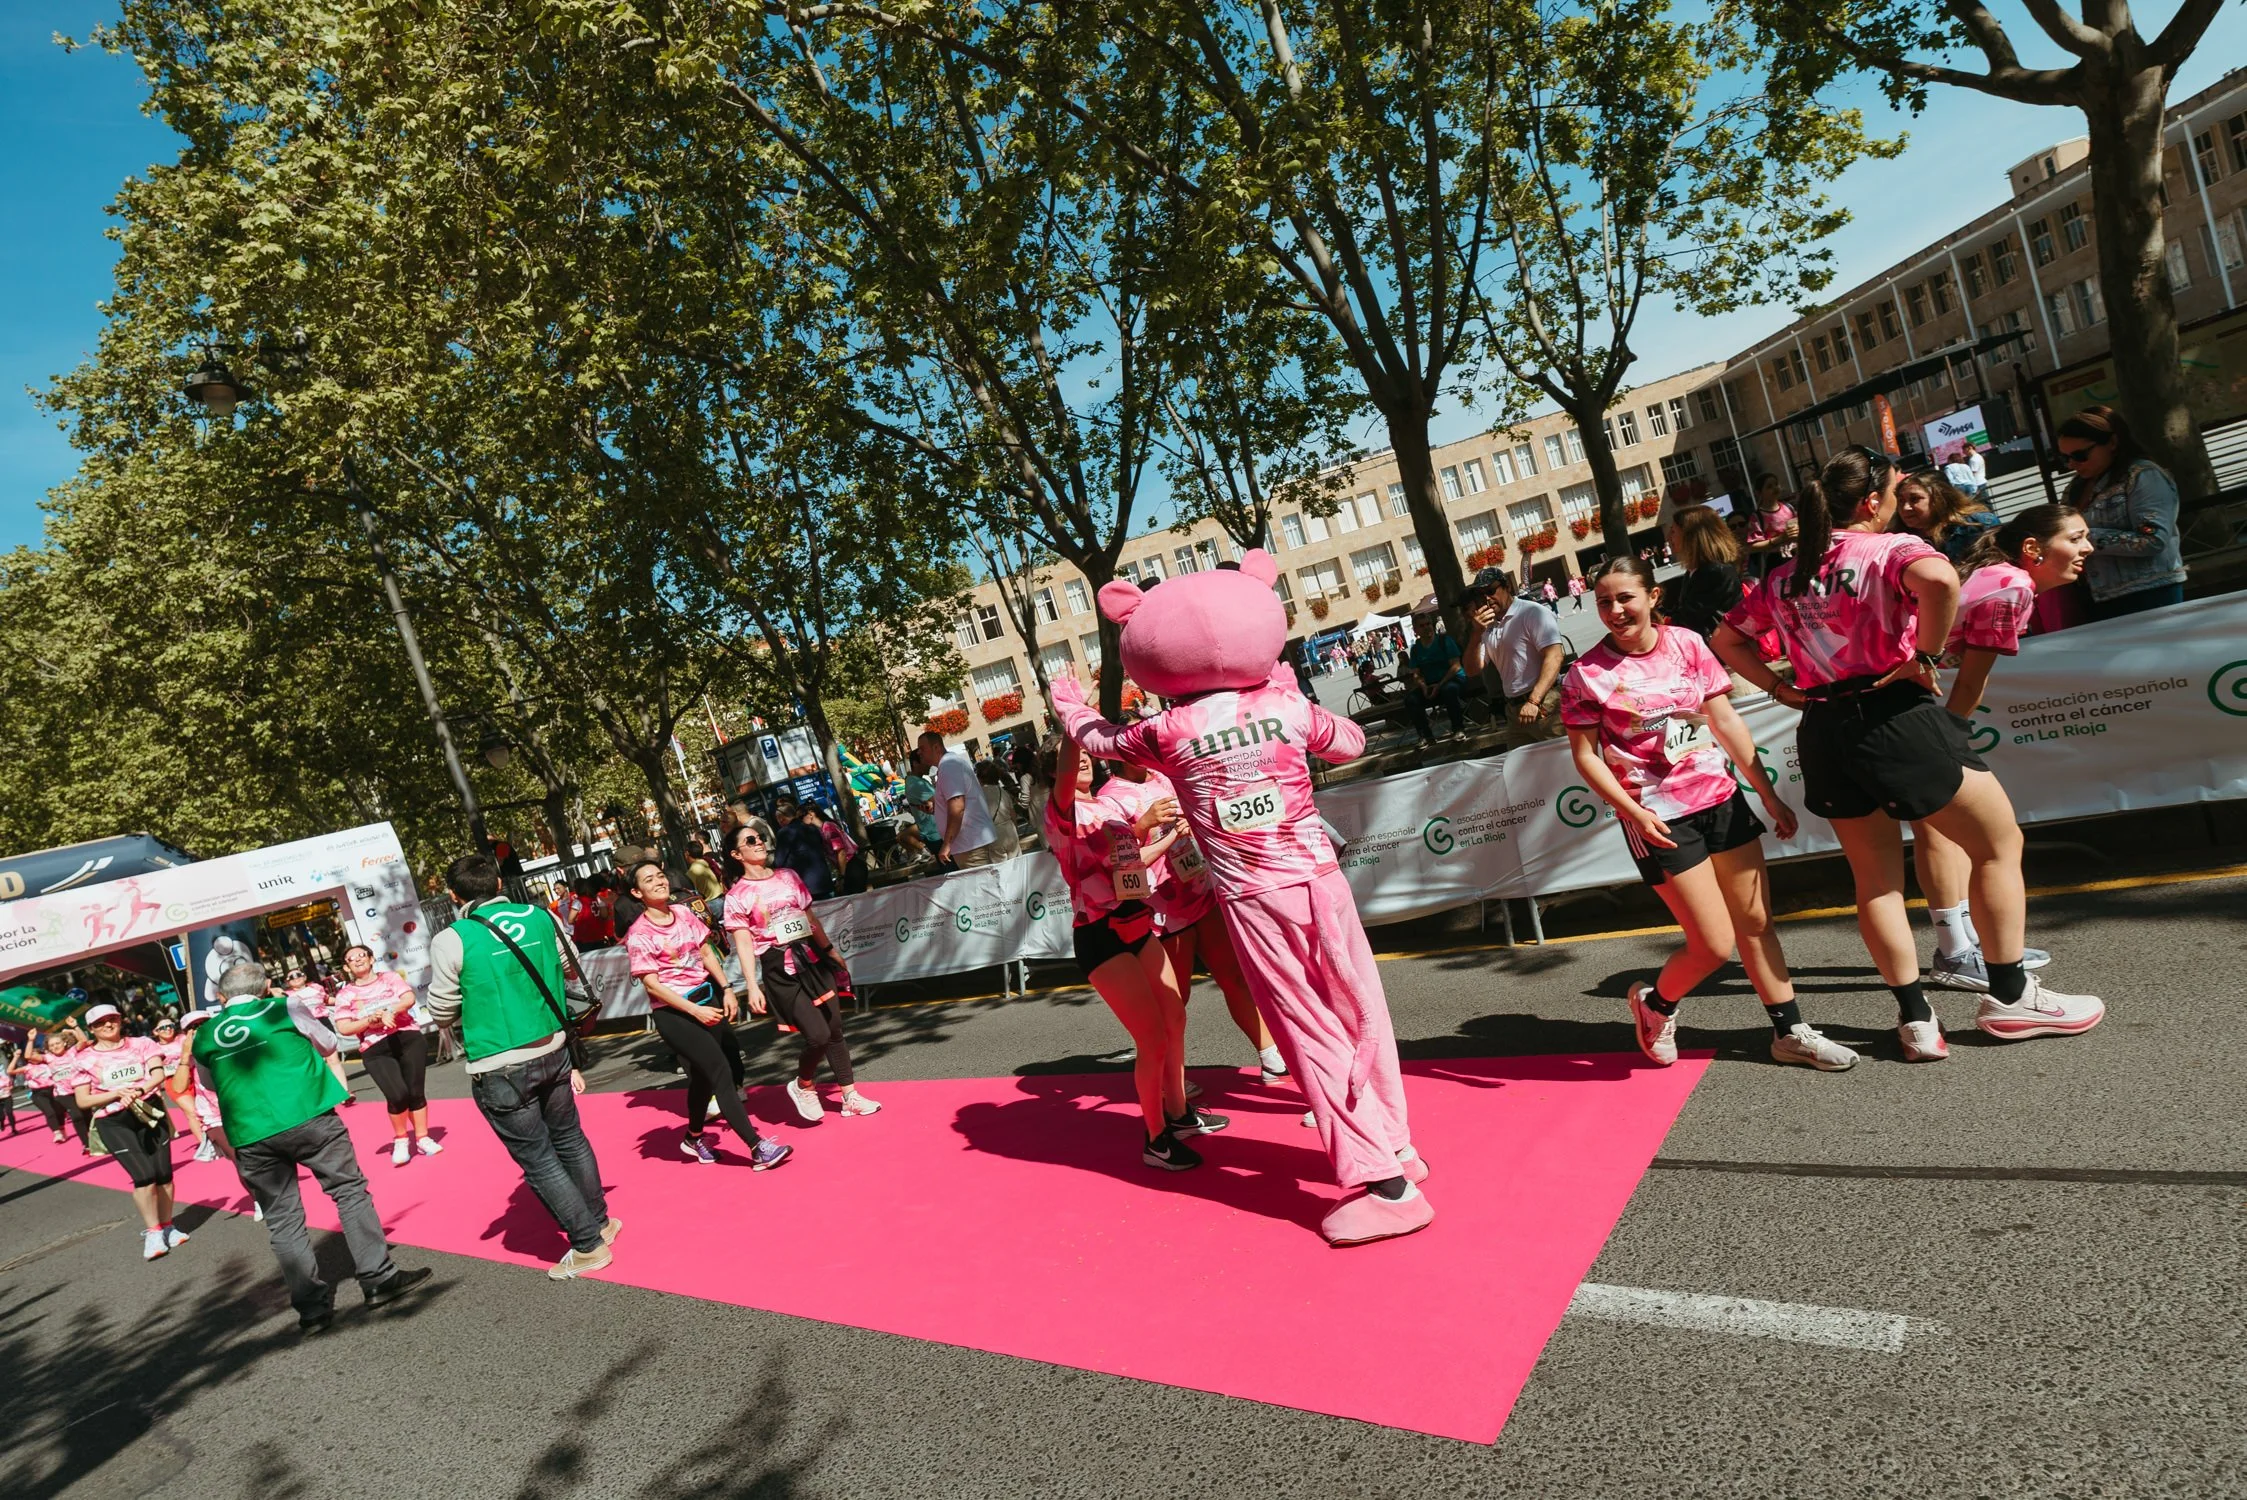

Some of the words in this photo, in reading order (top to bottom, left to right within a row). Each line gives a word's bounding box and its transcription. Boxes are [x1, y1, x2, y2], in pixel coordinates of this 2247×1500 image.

[1950, 422, 1975, 437] MASA
[2007, 690, 2100, 714] asociación
[2102, 676, 2189, 701] española
[2011, 711, 2066, 730] contra
[2069, 706, 2086, 721] el
[2089, 697, 2153, 718] cáncer
[2013, 733, 2034, 745] en
[2038, 728, 2059, 742] La
[2063, 720, 2108, 738] Rioja
[763, 740, 772, 751] P
[1229, 793, 1275, 823] 9365
[1456, 807, 1500, 825] asociación
[1500, 798, 1546, 816] española
[1458, 823, 1485, 836] contra
[1486, 821, 1495, 832] el
[1495, 814, 1528, 829] cáncer
[1346, 833, 1376, 846] ciación
[1377, 826, 1416, 841] española
[1459, 838, 1471, 848] en
[1471, 834, 1483, 846] La
[1484, 831, 1507, 844] Rioja
[1340, 847, 1362, 858] ontra
[1363, 845, 1370, 854] el
[1371, 841, 1401, 852] cáncer
[360, 852, 397, 869] Ferrer
[1347, 860, 1358, 868] La
[1360, 855, 1381, 866] Rioja
[1121, 873, 1141, 889] 650
[1048, 899, 1066, 908] contra
[1057, 907, 1065, 915] La
[974, 912, 990, 921] contra
[989, 911, 995, 919] el
[21, 925, 37, 935] la
[784, 920, 803, 934] 835
[110, 1066, 137, 1080] 8178
